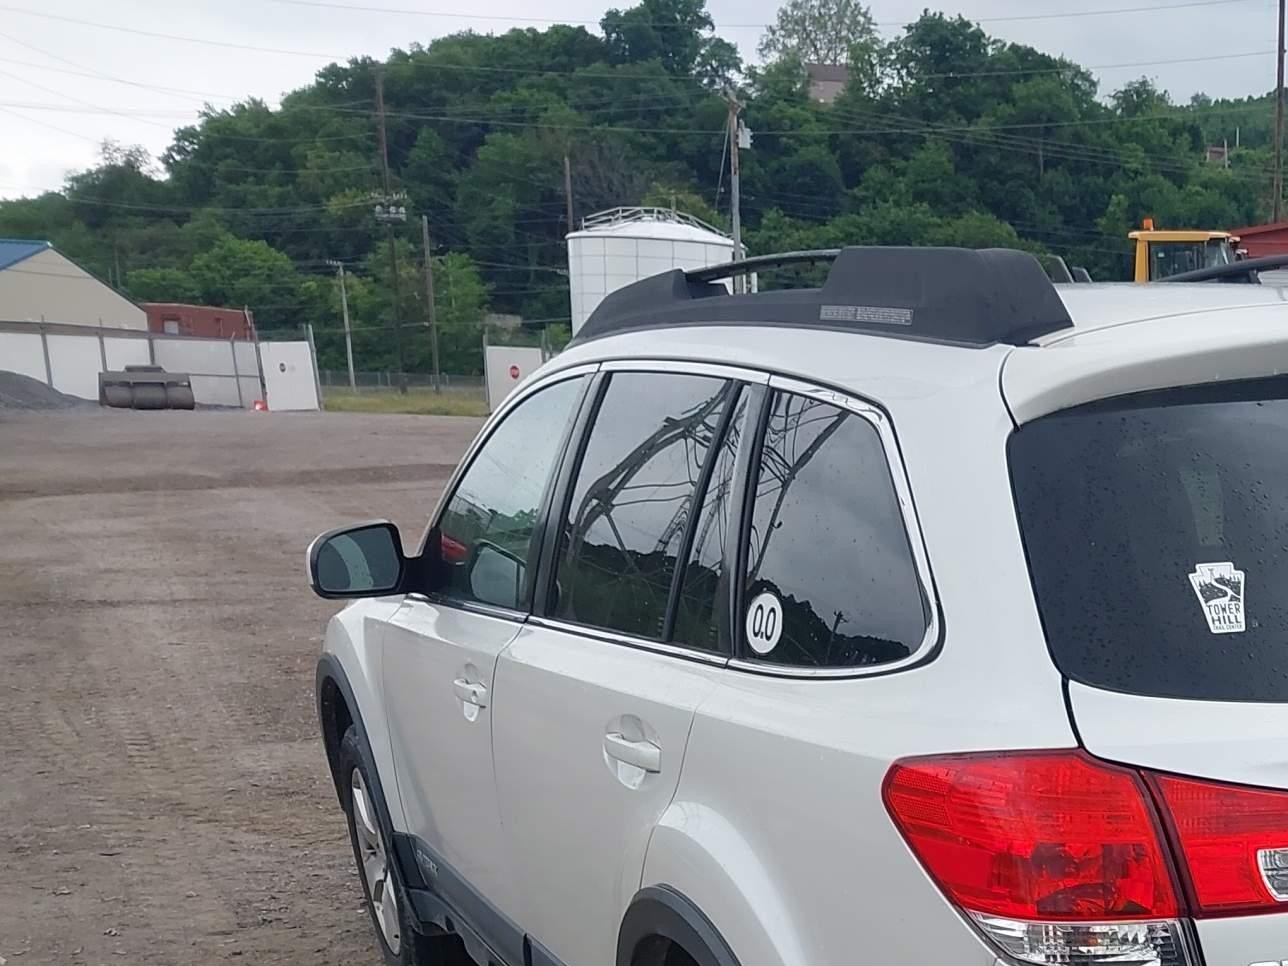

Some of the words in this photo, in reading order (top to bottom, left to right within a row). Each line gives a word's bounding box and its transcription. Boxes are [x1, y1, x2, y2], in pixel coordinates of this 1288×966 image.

[1206, 603, 1241, 615] TOWER
[753, 604, 776, 641] 0.0
[1211, 615, 1242, 625] HILL
